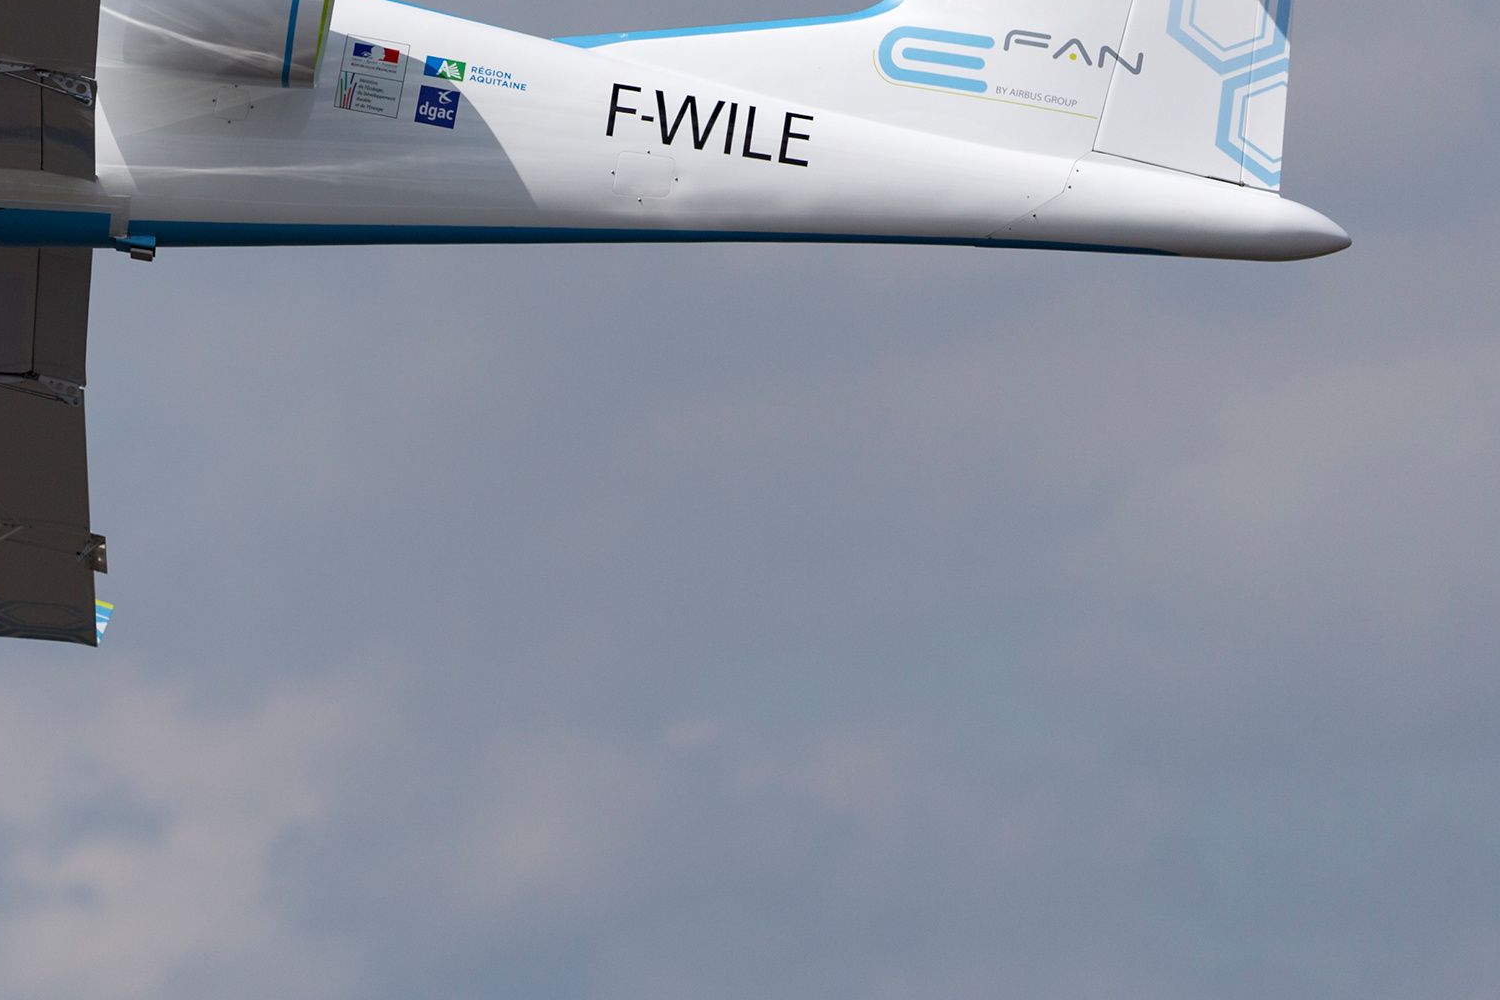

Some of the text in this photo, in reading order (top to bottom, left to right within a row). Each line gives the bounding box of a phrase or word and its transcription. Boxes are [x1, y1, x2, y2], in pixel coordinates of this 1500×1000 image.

[1003, 29, 1144, 75] FAN
[469, 74, 528, 91] AQUITAINE
[470, 64, 512, 80] RÉGION
[995, 85, 1078, 108] BY AIRBUS GROUP
[418, 101, 455, 121] dgac
[605, 82, 815, 168] F-WILE
